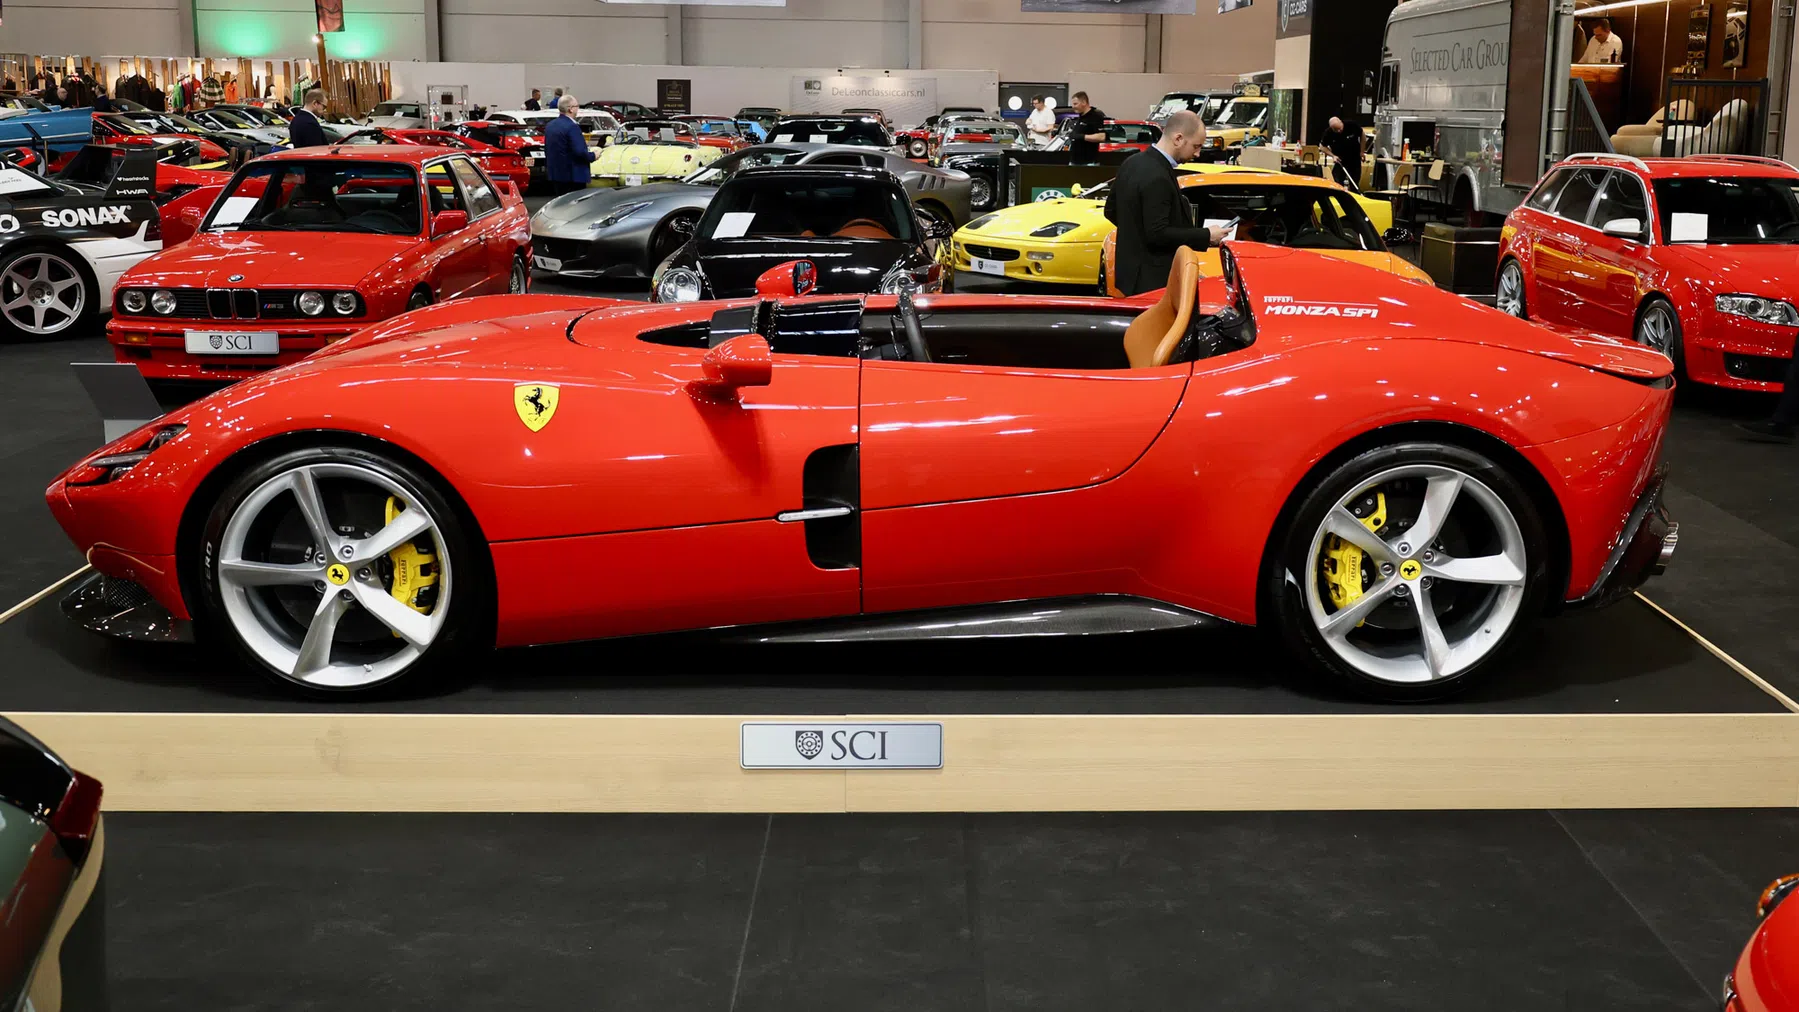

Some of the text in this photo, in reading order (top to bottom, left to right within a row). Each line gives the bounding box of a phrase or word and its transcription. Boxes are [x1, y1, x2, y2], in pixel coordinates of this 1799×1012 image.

[1410, 39, 1508, 74] SELECTED CAR GROU
[41, 205, 131, 227] SONAX
[1264, 305, 1341, 317] MONZA
[225, 335, 253, 350] SCI
[831, 730, 888, 760] SCI
